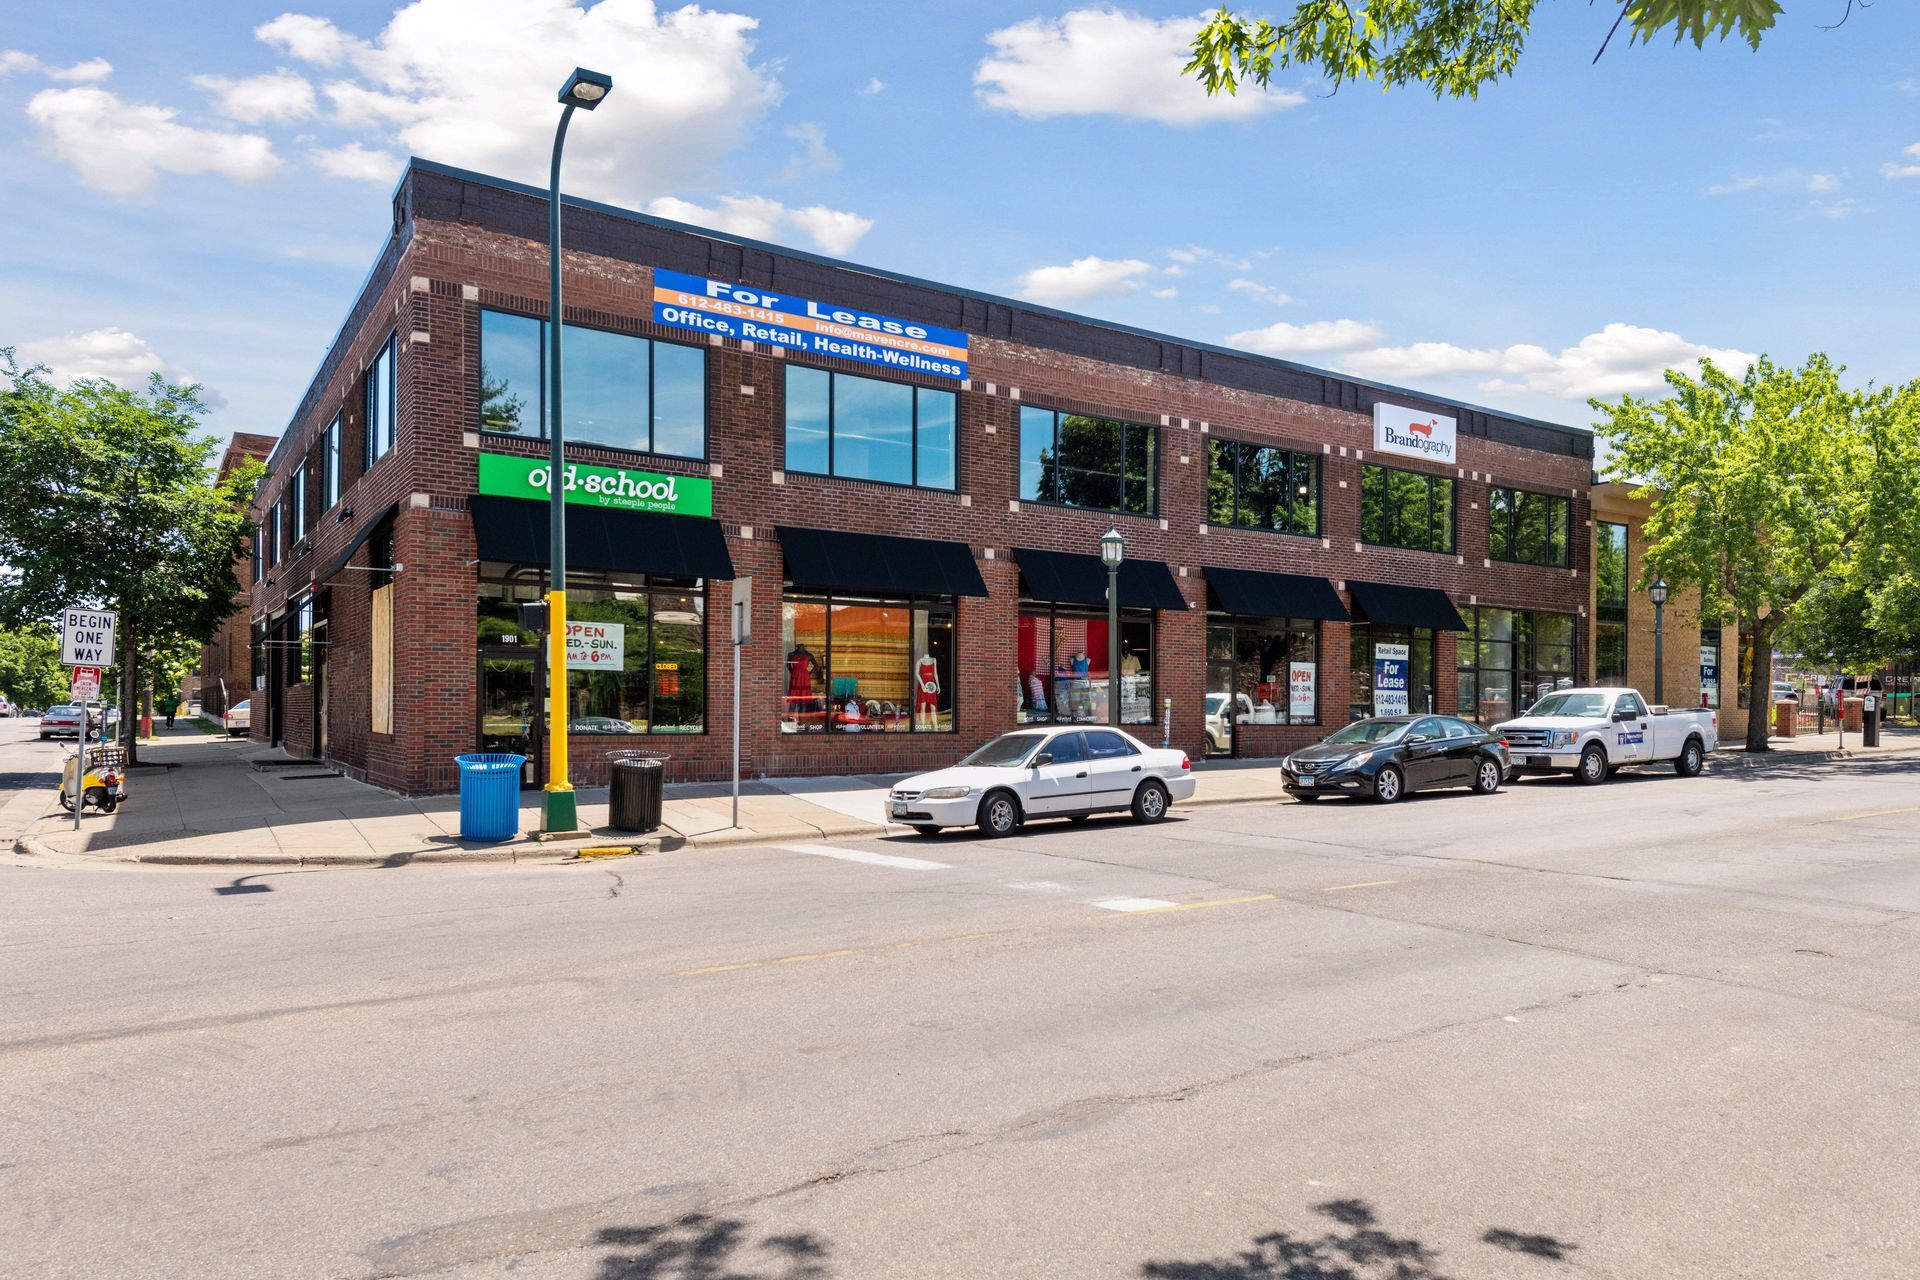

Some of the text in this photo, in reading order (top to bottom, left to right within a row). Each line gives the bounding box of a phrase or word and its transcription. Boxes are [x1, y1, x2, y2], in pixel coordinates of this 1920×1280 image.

[706, 280, 928, 339] For Lease
[677, 293, 951, 357] 612-483-1415 info@mavencre.com
[662, 307, 961, 376] Office, Retail, Health-Wellness
[1384, 426, 1452, 456] Brandography
[598, 494, 676, 511] by steeple people
[69, 614, 112, 629] BEGIN
[75, 631, 103, 645] ONE
[502, 634, 518, 644] 1901
[74, 648, 103, 662] WAY
[591, 651, 600, 663] 6
[1378, 646, 1406, 656] Retail Space
[1384, 661, 1400, 675] For
[1704, 666, 1713, 676] For
[1292, 670, 1312, 682] OPEN
[1378, 674, 1405, 688] Lease
[1376, 693, 1407, 705] 612-483-1415
